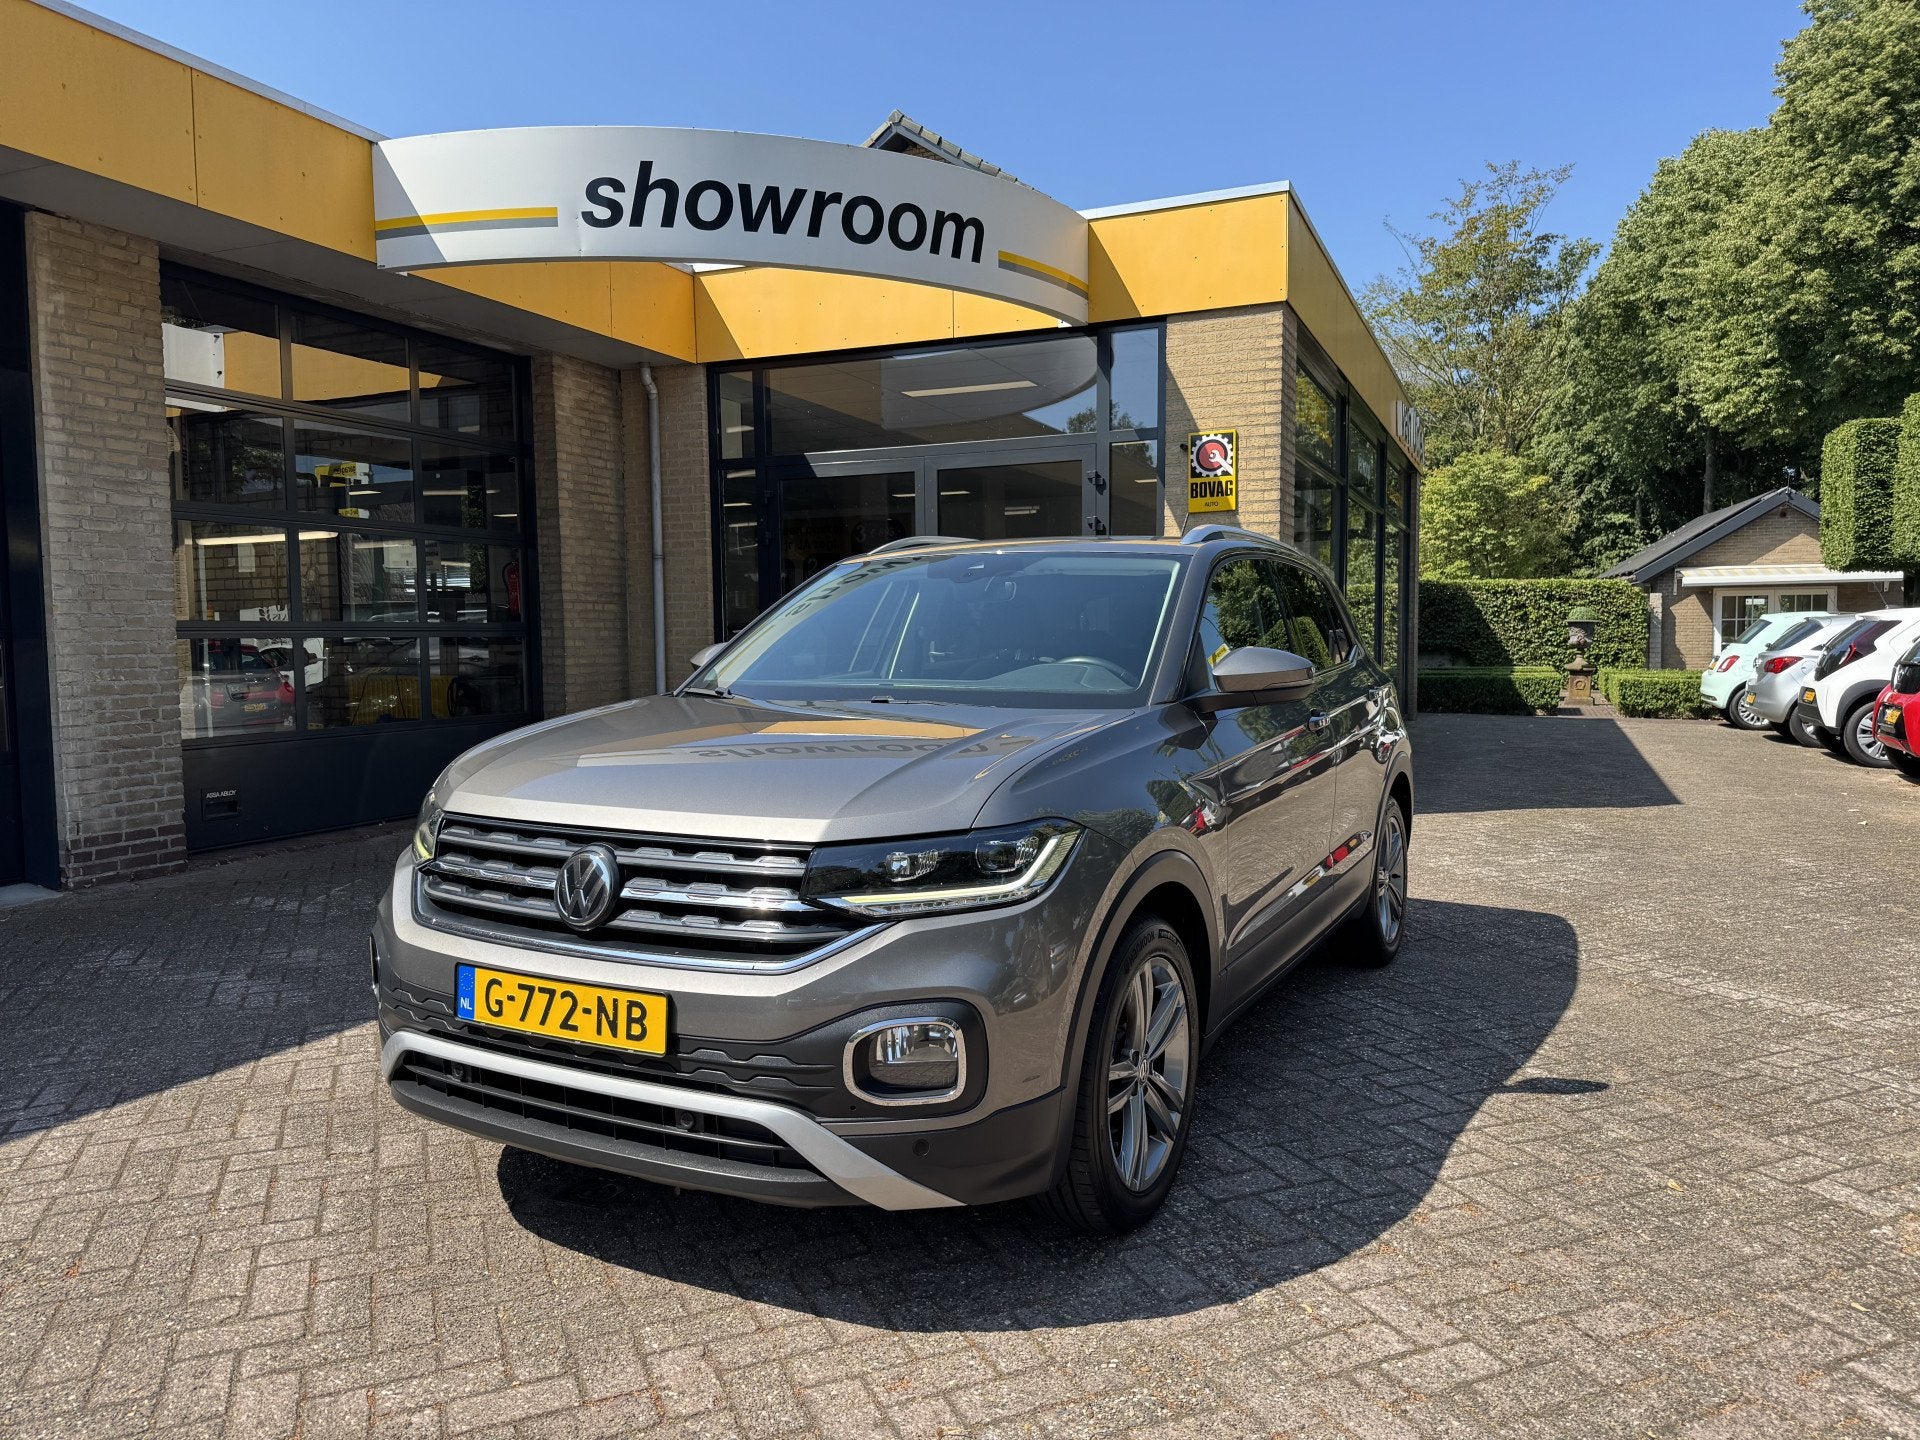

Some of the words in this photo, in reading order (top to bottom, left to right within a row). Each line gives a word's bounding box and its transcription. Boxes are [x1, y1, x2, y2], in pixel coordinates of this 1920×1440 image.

[581, 160, 985, 264] showroom
[1191, 480, 1233, 499] BOVAG
[460, 996, 473, 1011] NL
[485, 977, 648, 1042] G-772-NB
